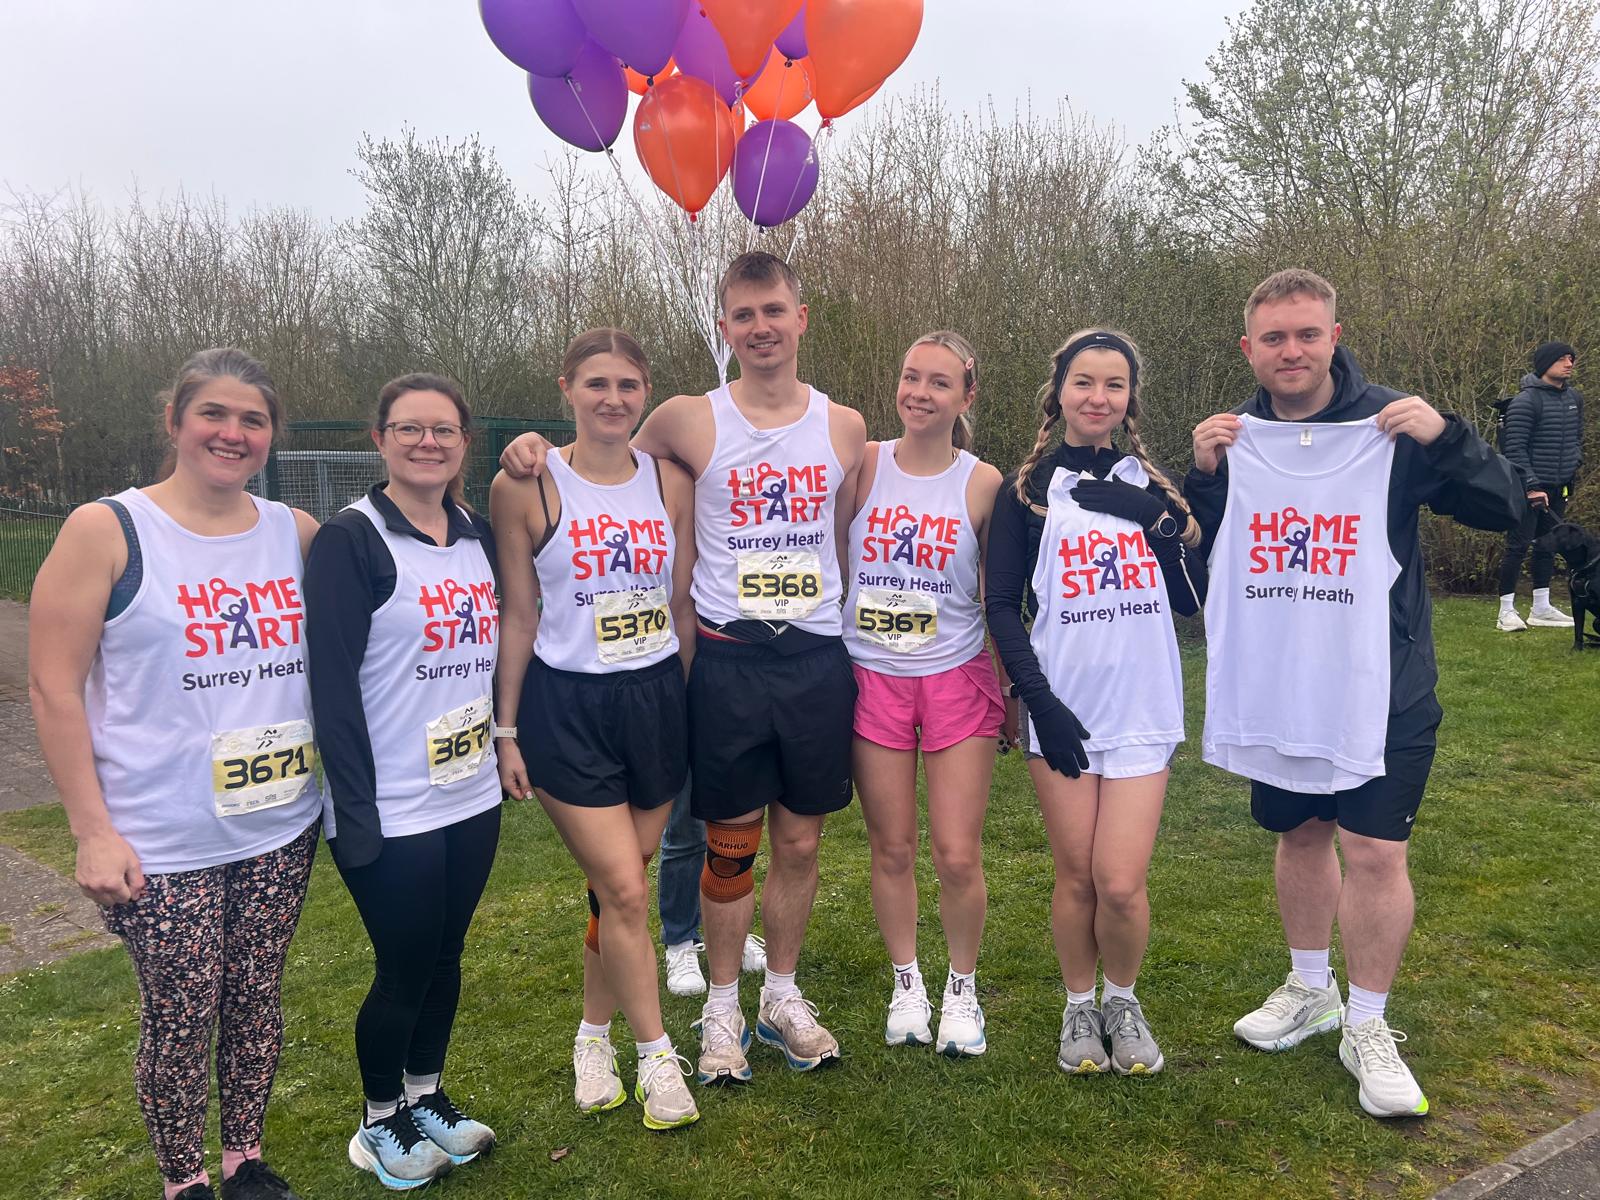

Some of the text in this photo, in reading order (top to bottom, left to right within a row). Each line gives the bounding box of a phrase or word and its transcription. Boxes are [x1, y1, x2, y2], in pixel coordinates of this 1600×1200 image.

[728, 462, 828, 498] HOME
[730, 496, 826, 527] START
[867, 505, 961, 545] HOME
[1249, 507, 1360, 545] HOME
[568, 514, 667, 548] HOME
[728, 536, 781, 551] Surrey
[572, 548, 667, 580] START
[861, 536, 955, 571] START
[1249, 546, 1356, 576] START
[742, 574, 818, 597] 5368
[858, 572, 952, 594] Surrey Heath
[1061, 561, 1157, 598] START
[1245, 584, 1354, 605] Surrey Heath
[177, 577, 302, 619] HOME
[774, 599, 789, 607] VIP
[1060, 600, 1160, 625] Surrey Heat
[184, 612, 304, 658] START
[601, 609, 666, 641] 5370
[860, 608, 933, 633] 5367
[633, 636, 647, 645] VIP
[887, 633, 902, 641] VIP
[182, 657, 305, 691] Surrey Heat
[416, 662, 471, 681] Surrey
[223, 745, 309, 789] 3671
